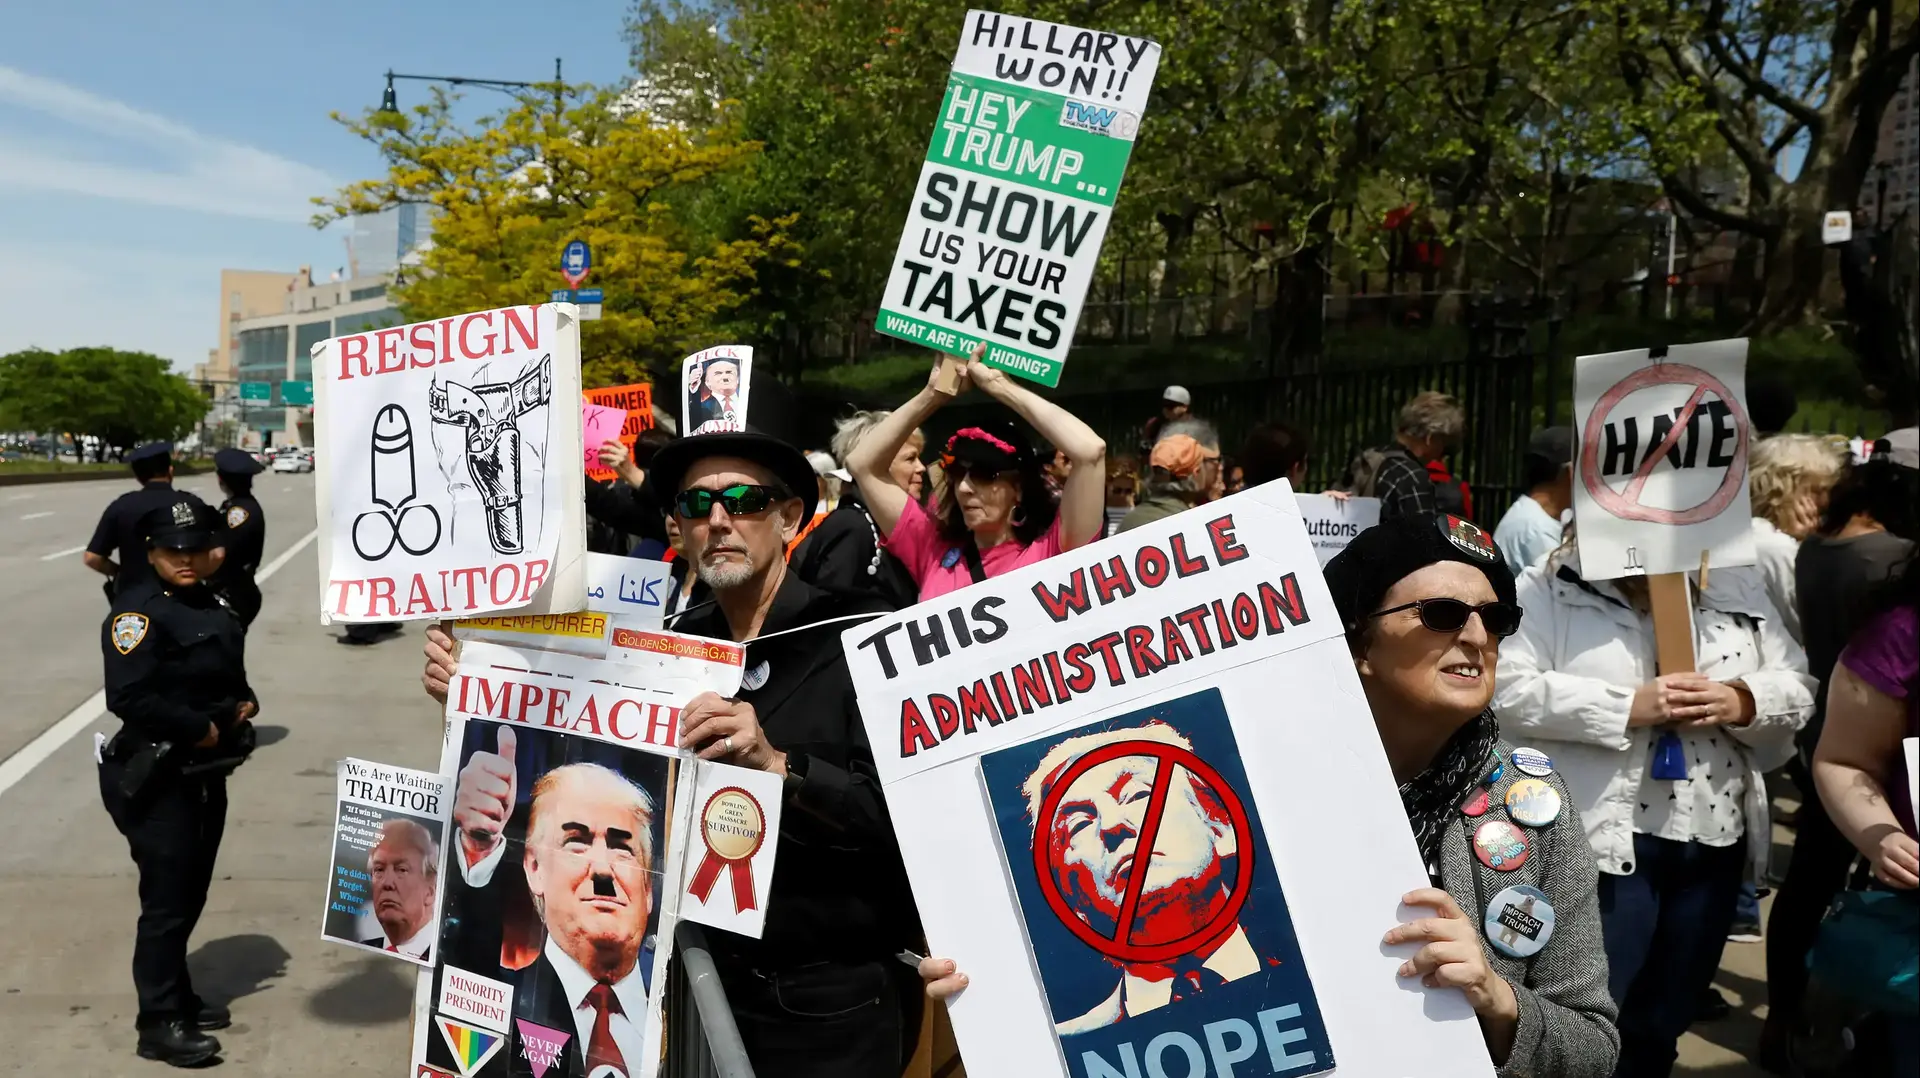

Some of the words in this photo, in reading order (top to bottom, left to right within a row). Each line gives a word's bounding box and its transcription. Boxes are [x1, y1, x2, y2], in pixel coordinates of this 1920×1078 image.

[996, 53, 1129, 101] WON!!
[946, 86, 1031, 134] HEY
[942, 121, 1107, 196] TRUMP...
[920, 172, 1098, 258] SHOW
[919, 227, 964, 265] US
[977, 242, 1067, 295] YOUR
[901, 260, 1066, 350] TAXES
[337, 304, 540, 381] RESIGN
[696, 348, 738, 363] FUCK
[886, 315, 926, 338] WHAT
[926, 329, 956, 349] ARE
[989, 347, 1051, 377] HIDING?
[593, 390, 647, 410] HOMER
[1602, 400, 1735, 476] HATE
[1450, 535, 1495, 561] RESIST
[329, 559, 550, 617] TRAITOR
[618, 573, 663, 607] كلنا
[858, 596, 1008, 679] THIS
[1031, 514, 1249, 623] WHOLE
[900, 572, 1310, 758] ADMINISTRATION
[455, 675, 684, 748] IMPEACH
[346, 764, 367, 778] We
[371, 768, 392, 782] Are
[395, 773, 444, 795] Waiting
[346, 779, 439, 814] TRAITOR
[722, 800, 747, 810] BOWLING
[342, 814, 366, 826] election
[719, 815, 748, 826] MASSACRE
[724, 808, 744, 817] GREEN
[340, 834, 353, 842] Tax
[708, 822, 756, 838] SURVIVOR
[337, 866, 349, 875] We
[332, 902, 346, 911] Are
[1504, 904, 1542, 930] IMPEACH
[1504, 916, 1532, 935] TRUMP
[449, 975, 506, 1003] MINORITY
[445, 992, 507, 1022] PRESIDENT
[520, 1033, 562, 1056] NEVER
[520, 1049, 561, 1070] AGAIN
